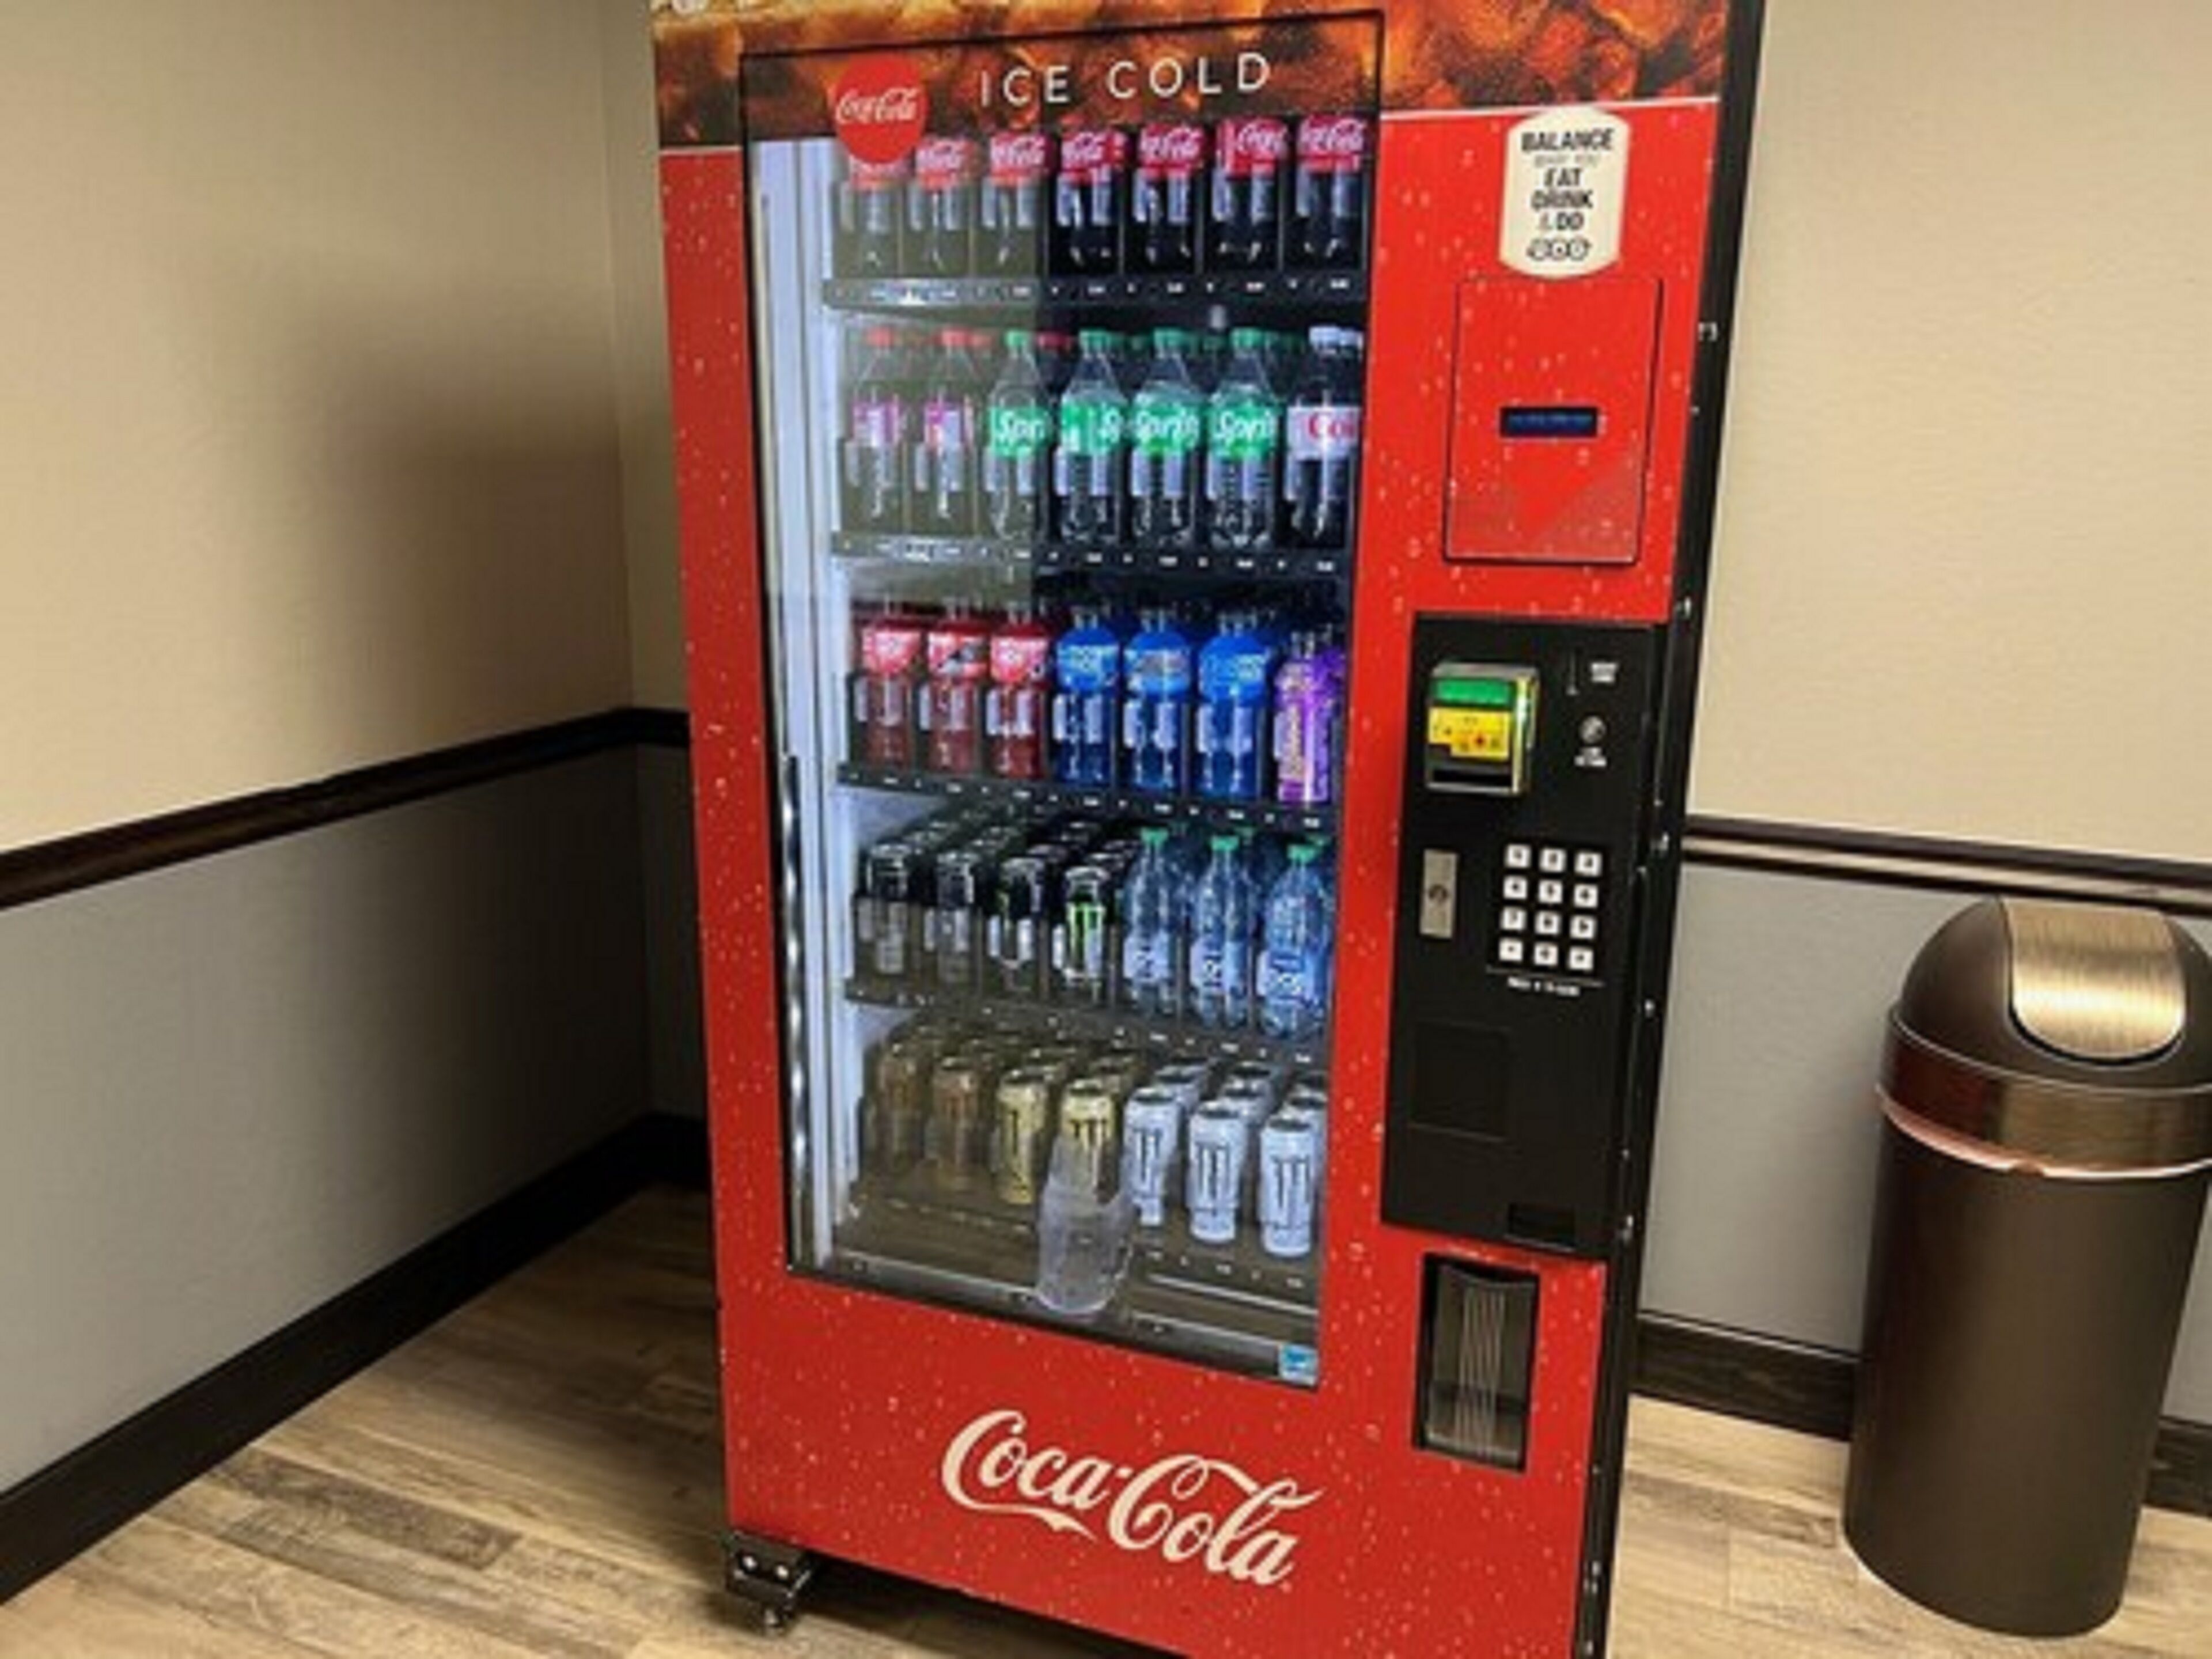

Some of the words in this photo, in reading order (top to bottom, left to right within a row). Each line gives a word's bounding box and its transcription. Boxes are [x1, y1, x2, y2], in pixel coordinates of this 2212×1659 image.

[981, 65, 1070, 107] ICE
[1106, 52, 1270, 99] COLD
[836, 87, 918, 124] Coca-Cola
[1521, 128, 1613, 153] BALANCE
[1543, 168, 1581, 186] EAT
[1531, 189, 1593, 211] DRINK
[1556, 211, 1585, 231] DO
[942, 1410, 1325, 1586] Coca-Cola
